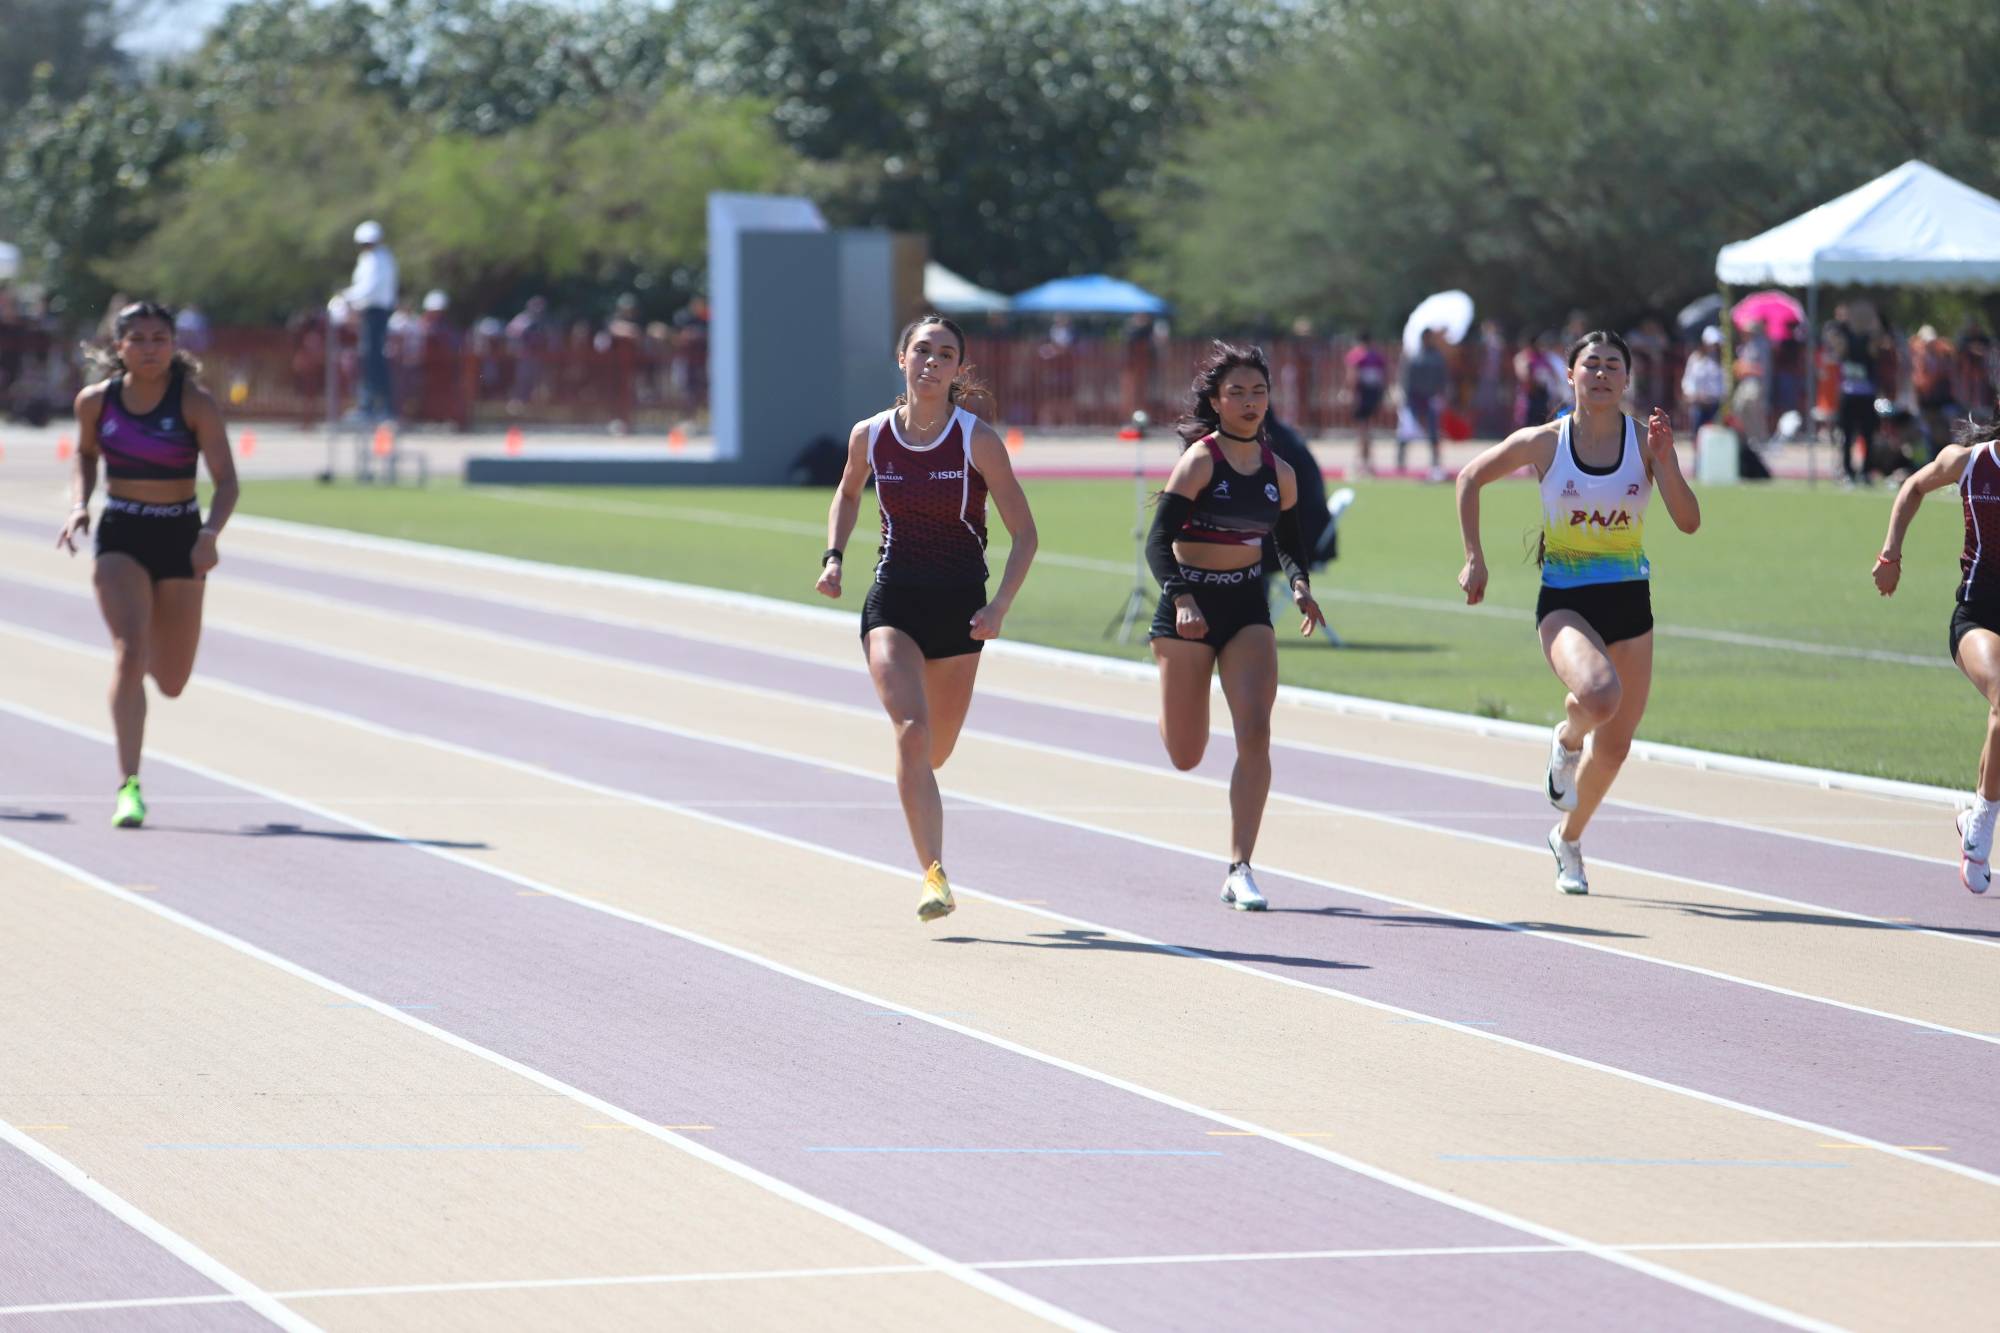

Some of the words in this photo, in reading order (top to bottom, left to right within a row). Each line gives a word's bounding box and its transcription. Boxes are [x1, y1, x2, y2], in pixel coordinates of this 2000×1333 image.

[142, 504, 182, 518] PRO
[1570, 510, 1631, 527] BAJA
[1204, 571, 1243, 585] PRO
